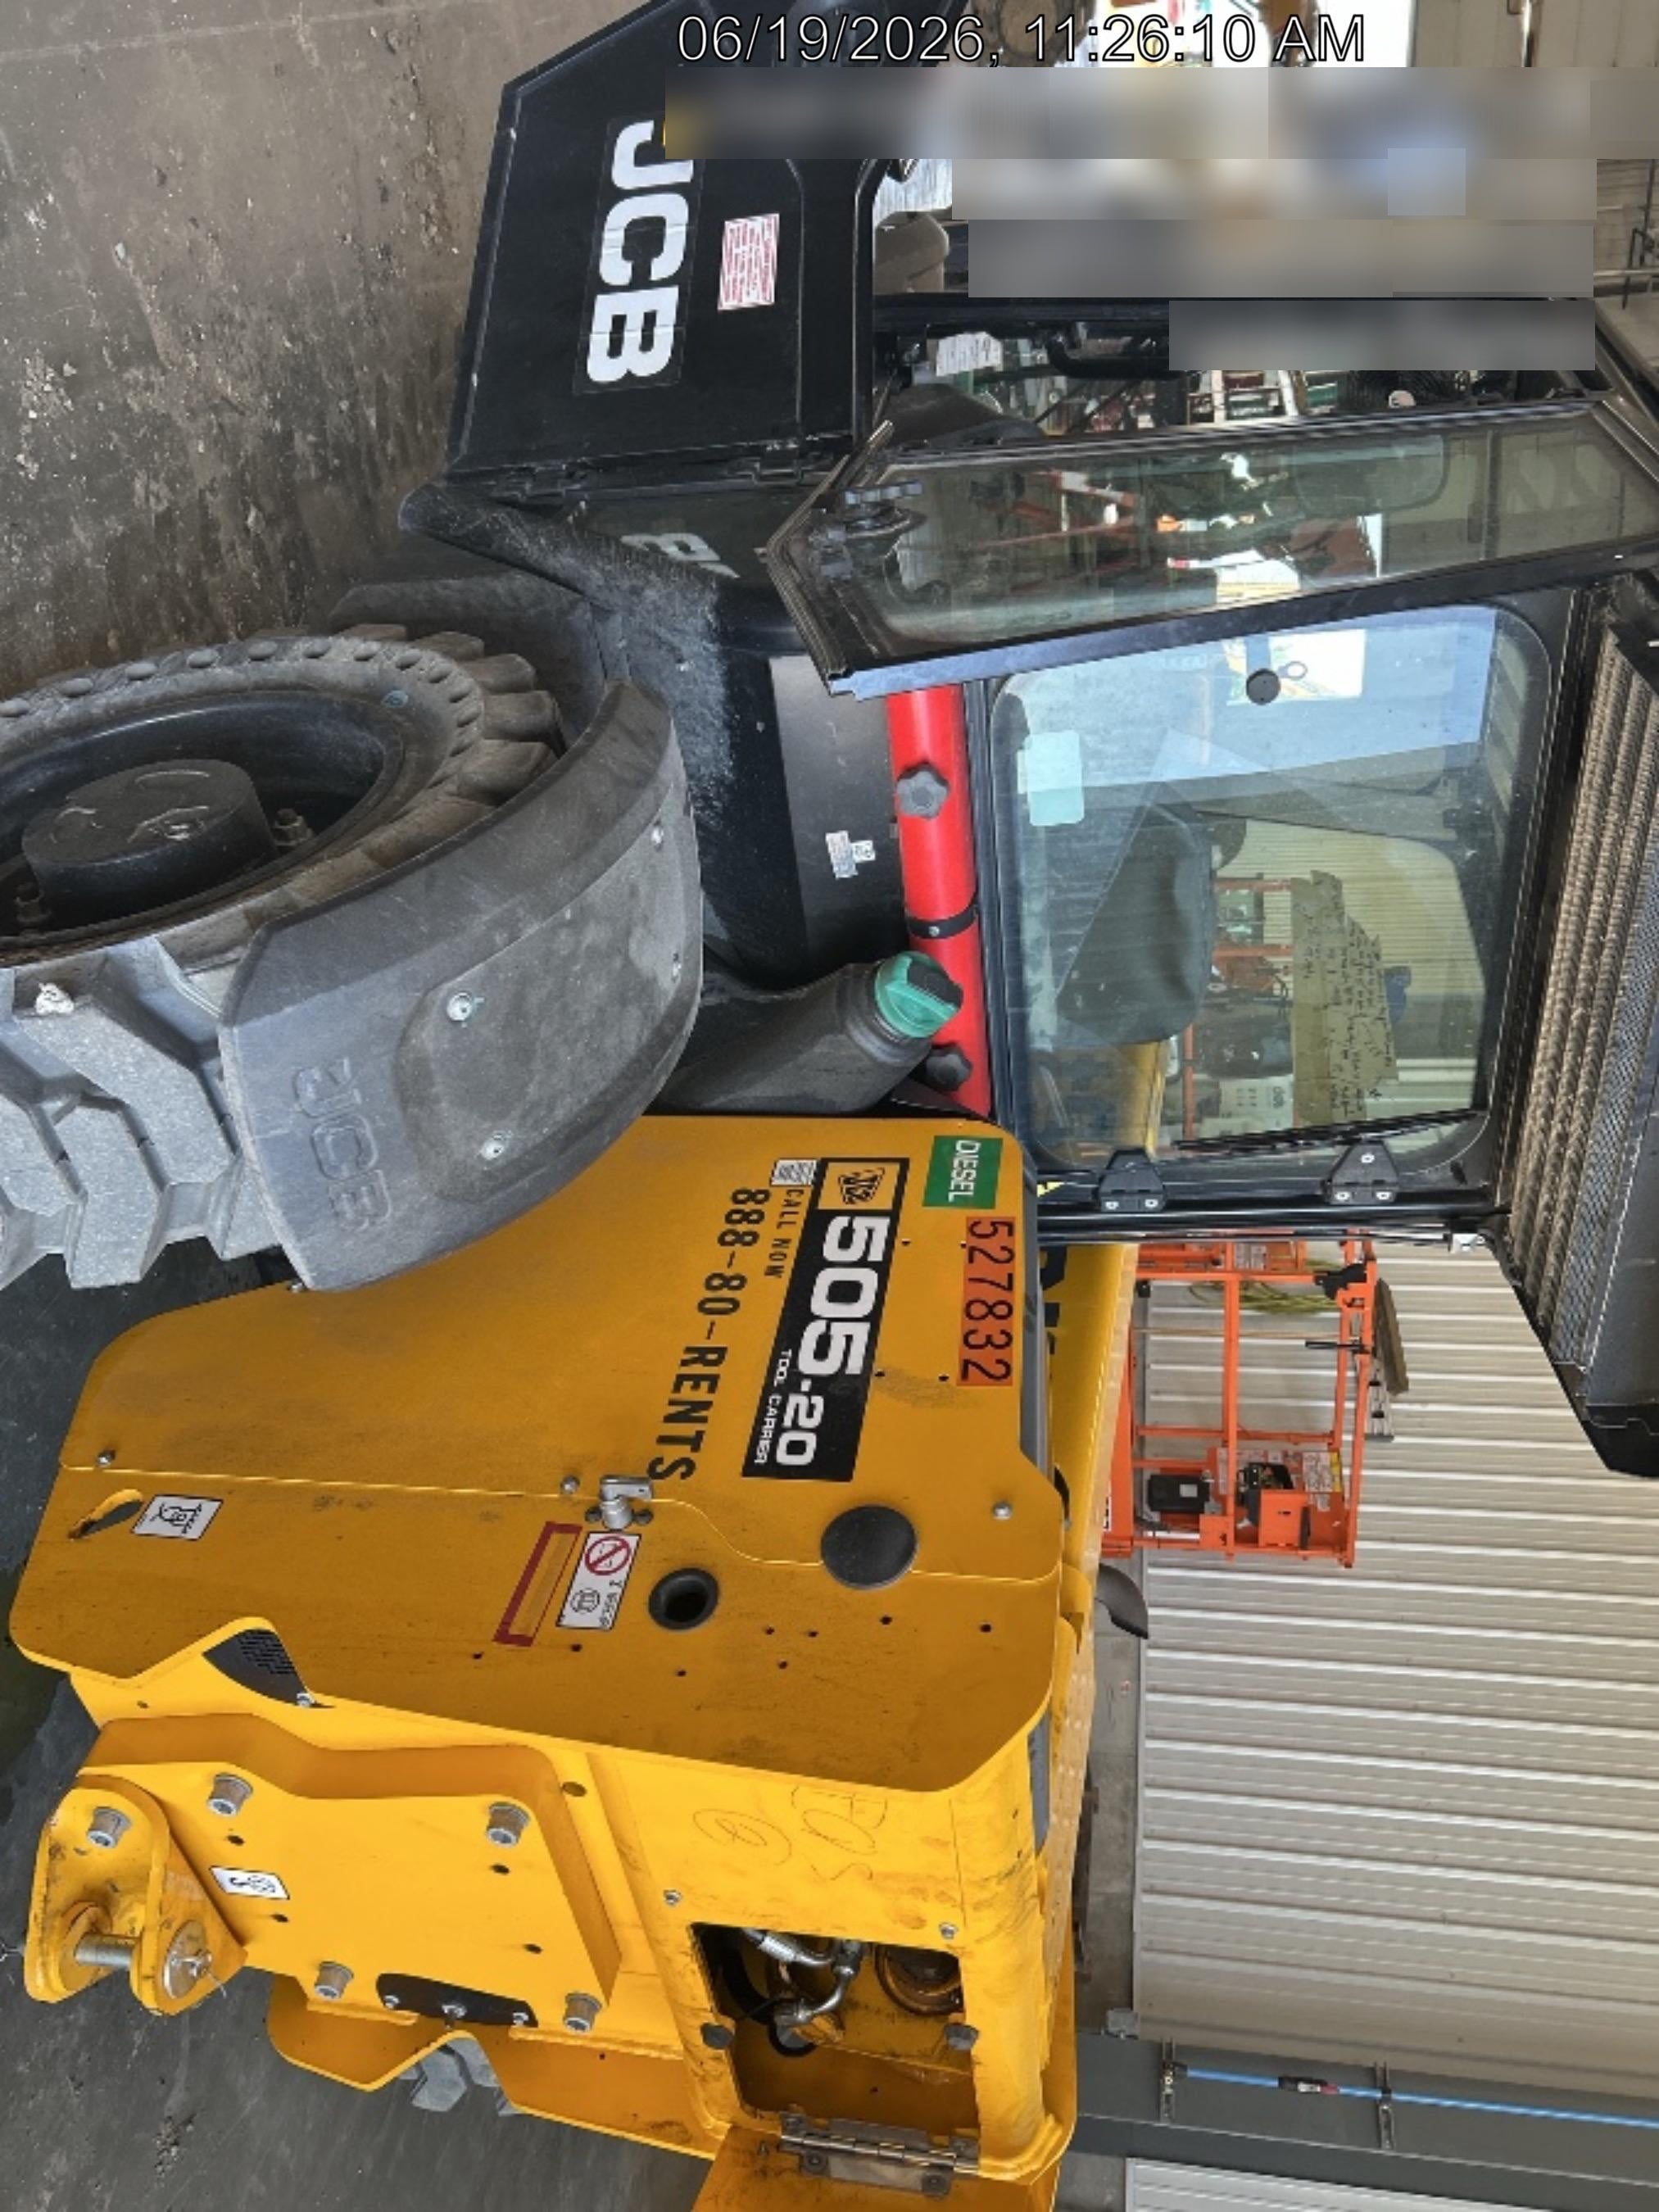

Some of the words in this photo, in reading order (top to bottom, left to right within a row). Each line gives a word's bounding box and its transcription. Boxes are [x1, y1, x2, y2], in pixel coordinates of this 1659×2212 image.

[586, 120, 694, 383] JCB
[292, 1057, 392, 1231] JCB
[948, 1139, 981, 1202] DIESEL
[764, 1238, 792, 1278] NOW
[777, 1189, 805, 1230] CALL
[647, 1188, 772, 1480] 888-80-RENTS
[775, 1216, 891, 1466] 505-20
[960, 1220, 1015, 1380] 527832
[773, 1349, 792, 1388] TOOL
[754, 1394, 782, 1464] CARRIER
